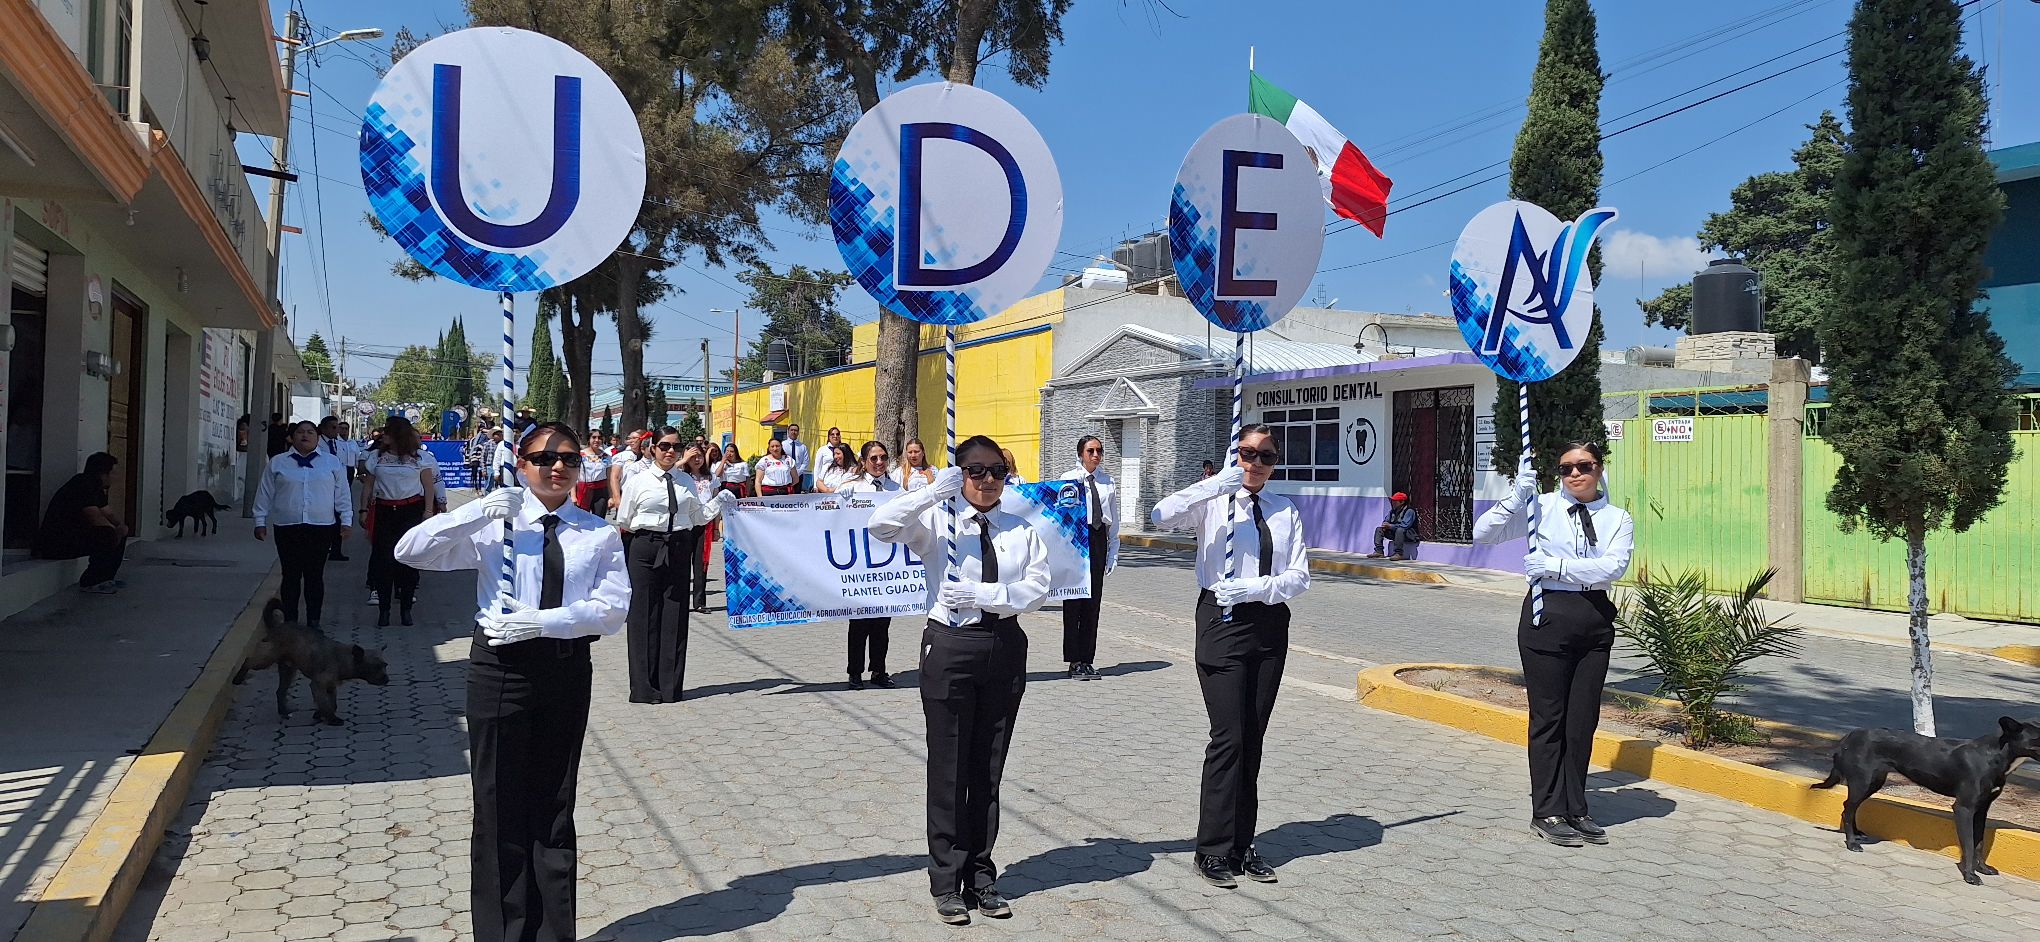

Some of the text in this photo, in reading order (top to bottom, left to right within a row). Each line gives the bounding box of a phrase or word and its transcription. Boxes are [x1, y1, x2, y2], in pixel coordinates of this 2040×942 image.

[431, 63, 581, 248] U
[898, 122, 1027, 286] D
[1217, 149, 1283, 296] E
[666, 383, 705, 393] BIBLIOTEC
[1256, 381, 1383, 406] CONSULTORIO DENTAL
[1671, 426, 1686, 434] NO
[841, 570, 909, 583] UNIVERSIDAD
[842, 583, 929, 597] PLANTEL GUADA
[730, 614, 756, 625] CIENCIAS
[757, 613, 766, 622] DE
[777, 609, 812, 620] EDUCACIÓN
[816, 607, 853, 618] AGRONOMÍA
[856, 605, 884, 615] DERECHO
[911, 602, 927, 612] ORAL
